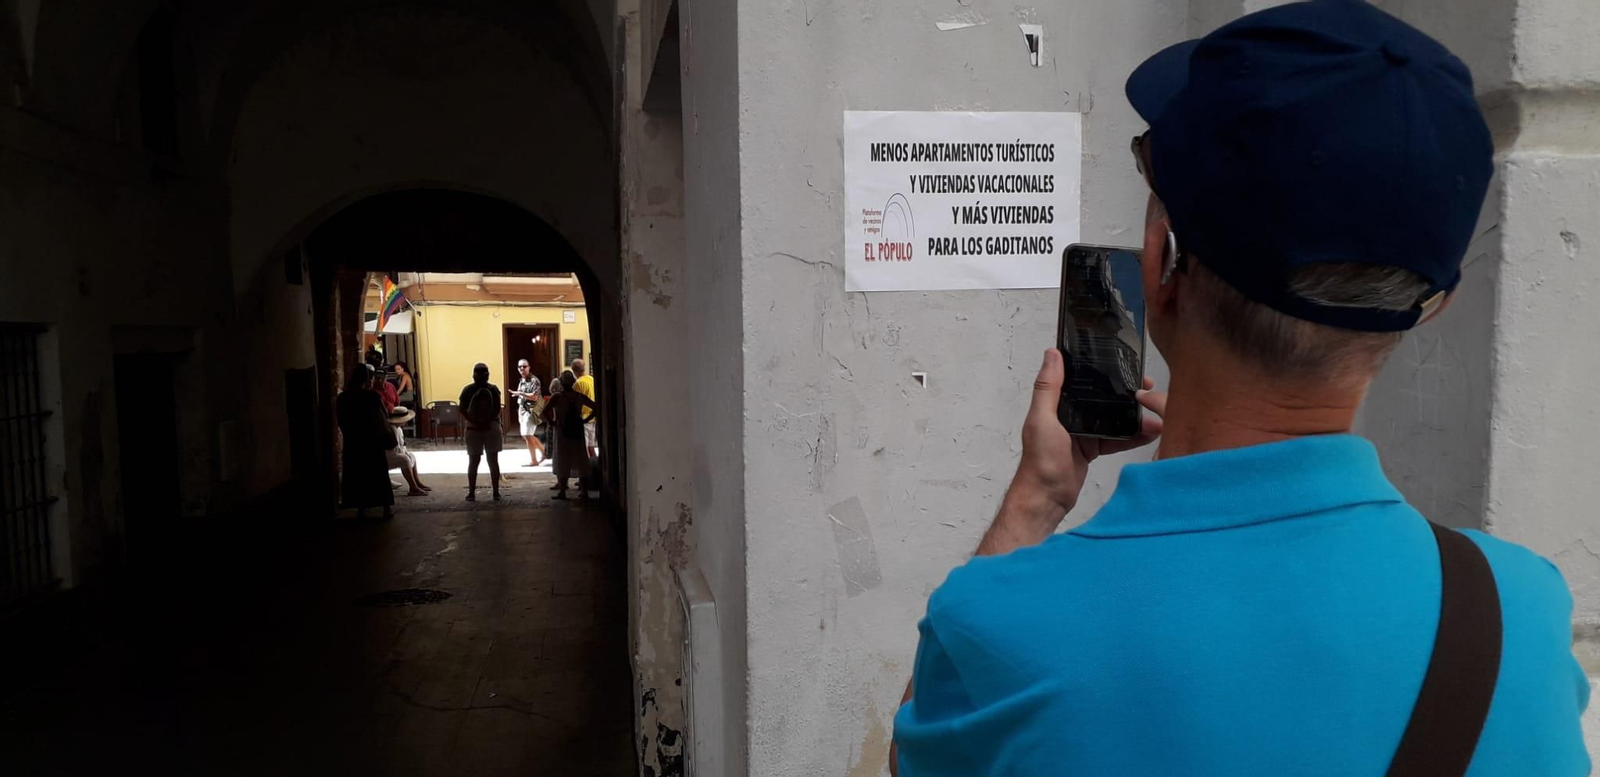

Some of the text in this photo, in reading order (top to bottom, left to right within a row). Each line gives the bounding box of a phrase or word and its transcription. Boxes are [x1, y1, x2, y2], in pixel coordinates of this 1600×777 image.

[870, 139, 1055, 162] MENOS APARTAMENTOS TURÍSTICOS
[909, 175, 1055, 193] Y VIVIENDAS VACACIONALES
[862, 208, 882, 217] Plataforma
[862, 216, 868, 224] de
[951, 201, 1054, 225] Y MÁS VIVIENDAS
[864, 238, 913, 261] EL PÓPULO
[928, 236, 1054, 256] PARA LOS GADITANOS
